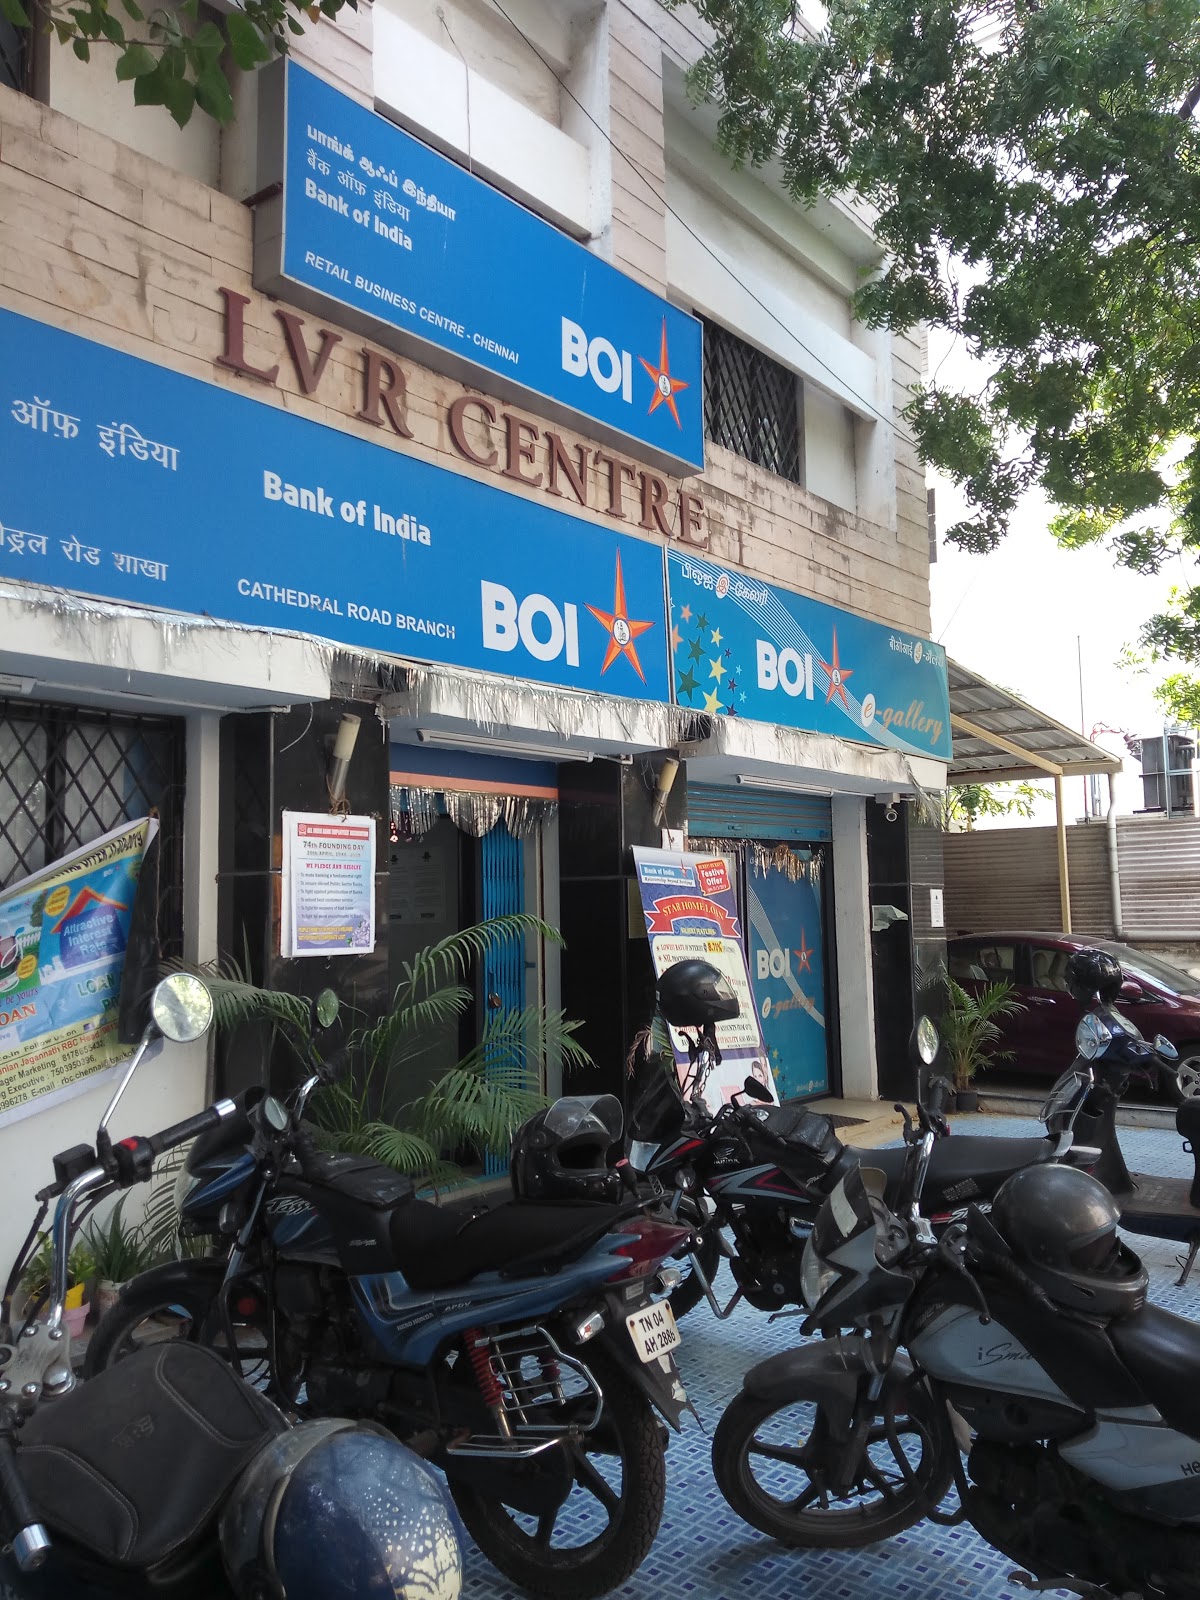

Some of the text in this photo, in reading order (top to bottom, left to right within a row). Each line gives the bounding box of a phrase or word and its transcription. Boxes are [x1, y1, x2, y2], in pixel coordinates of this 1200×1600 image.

[307, 124, 456, 221] பாங்க் ஆஃப் இந்தியா
[306, 148, 331, 176] बैंक
[372, 189, 410, 222] इंडिया
[305, 177, 412, 251] Bank of India
[305, 250, 352, 284] RETAIL
[355, 275, 417, 315] BUSINESS
[419, 306, 465, 338] CENTRE
[473, 332, 519, 364] CHENNAI
[561, 315, 632, 404] BOI
[217, 286, 710, 549] LVR CENTRE
[96, 421, 180, 471] इंडिया
[263, 470, 431, 546] Bank of India
[60, 534, 101, 566] रोड
[111, 552, 169, 581] शाखा
[237, 578, 455, 640] CATHEDRAL ROAD BRANCH
[481, 579, 579, 667] BOI
[756, 639, 814, 701] BOI
[863, 698, 944, 746] e-gallery
[318, 842, 352, 850] FOUNDING
[663, 868, 675, 876] India
[701, 868, 725, 878] Festive
[706, 877, 723, 886] Offer
[662, 901, 724, 920] STAR HOME LOAN
[63, 914, 114, 936] Attractive
[68, 926, 112, 946] Interest
[79, 940, 107, 956] Rate
[757, 948, 791, 980] BOI
[16, 987, 38, 1006] yours
[77, 974, 115, 997] LOAN
[20, 1046, 60, 1067] Jagannath
[61, 1038, 78, 1051] RBC
[80, 1030, 100, 1044] Head
[24, 1038, 52, 1052] Follow
[66, 1029, 77, 1037] on
[18, 1059, 56, 1079] Marketing
[7, 1075, 45, 1095] Executive
[31, 1081, 56, 1097] E-mail
[412, 1312, 435, 1326] HONDA
[639, 1310, 664, 1333] TN 04
[644, 1336, 659, 1355] AH
